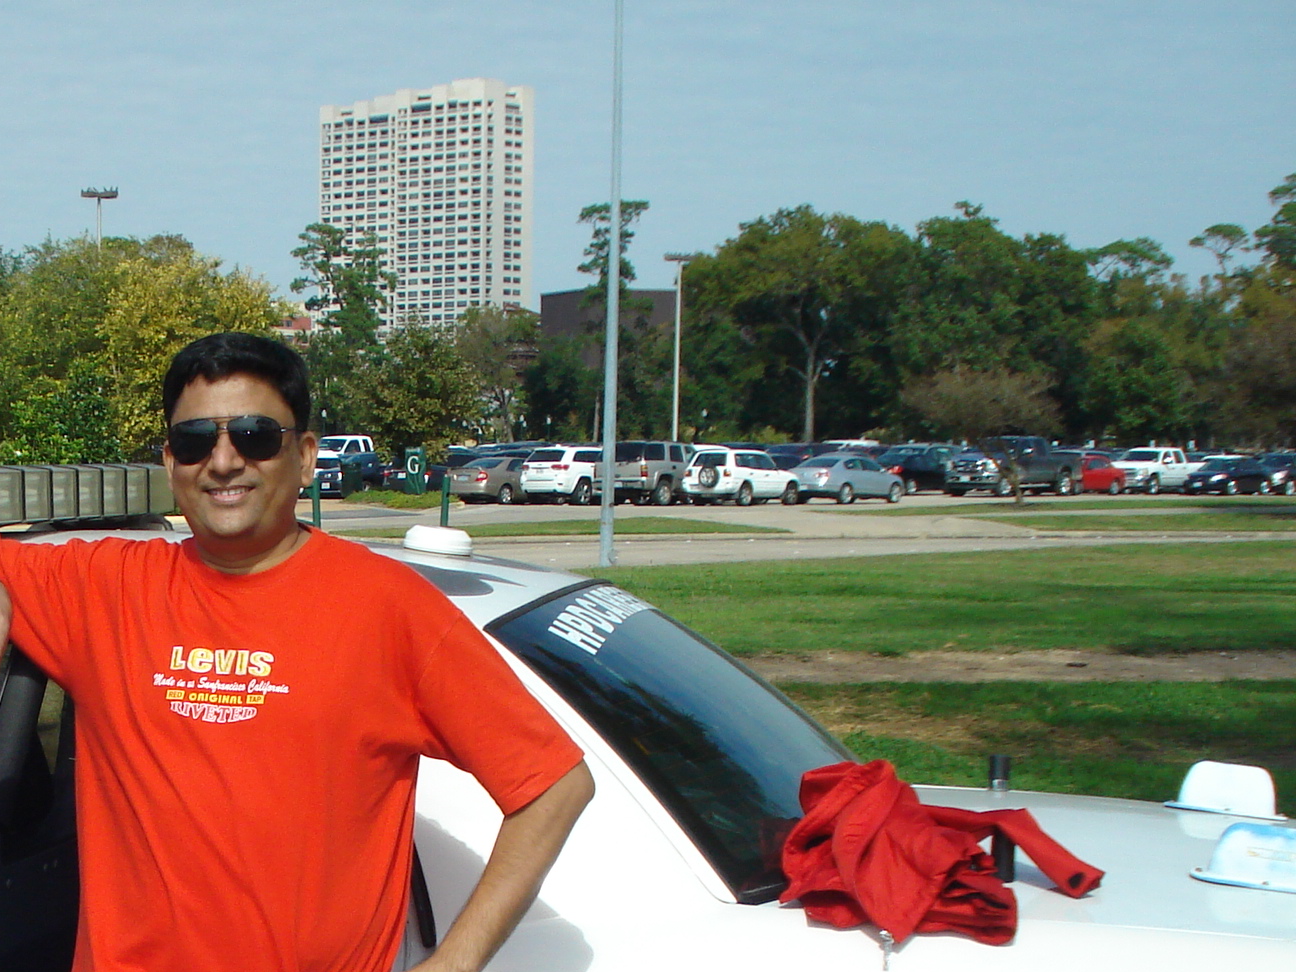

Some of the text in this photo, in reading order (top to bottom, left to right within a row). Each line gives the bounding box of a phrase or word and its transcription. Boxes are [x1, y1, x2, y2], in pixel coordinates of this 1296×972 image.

[407, 455, 420, 474] G
[153, 673, 175, 687] Made
[247, 679, 290, 695] California
[170, 701, 258, 723] RIVETED
